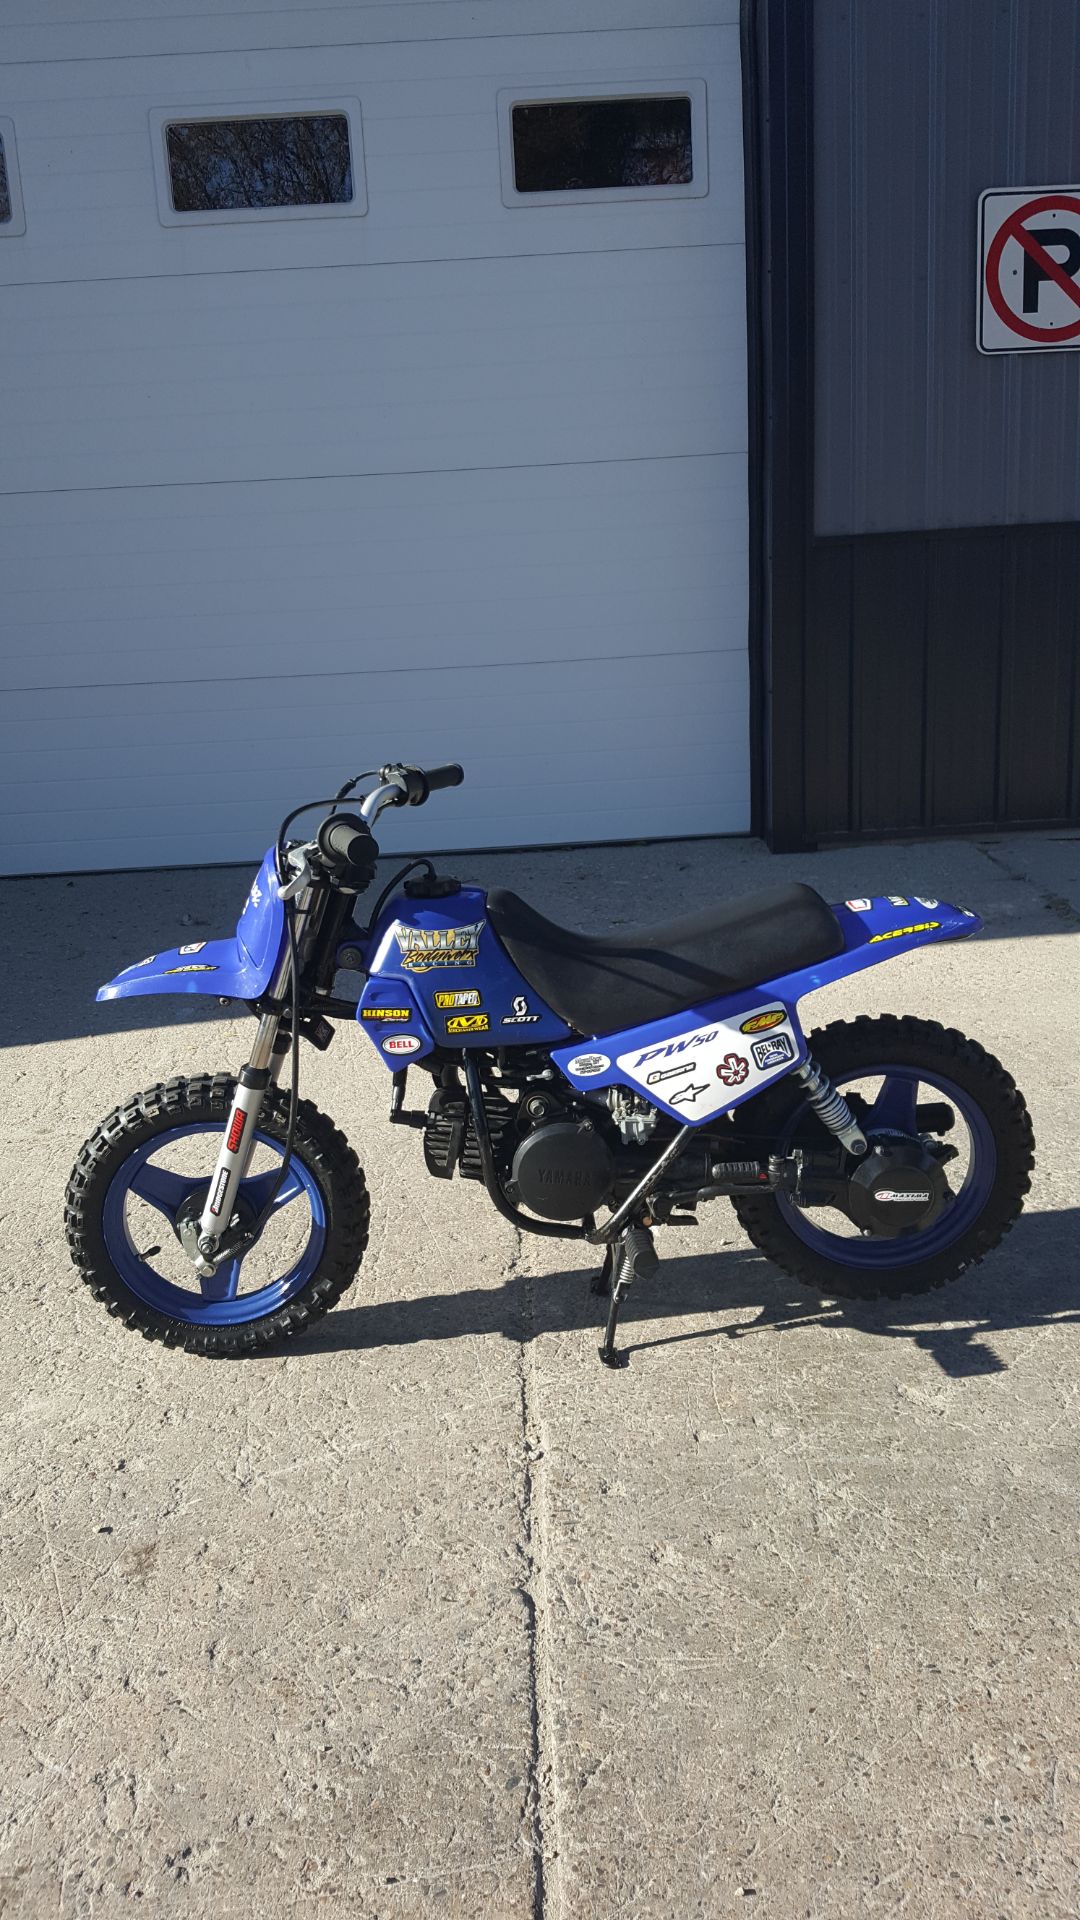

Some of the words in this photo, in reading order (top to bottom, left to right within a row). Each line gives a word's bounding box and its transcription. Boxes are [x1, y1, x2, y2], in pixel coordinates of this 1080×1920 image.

[1022, 228, 1080, 314] P
[395, 920, 486, 952] VALLEY
[408, 960, 473, 968] RACING
[362, 1009, 410, 1018] HINSON
[502, 1015, 539, 1024] SCOTT
[741, 1011, 785, 1032] FMF
[389, 1040, 415, 1049] BELL
[633, 1030, 720, 1069] PW50
[228, 1109, 245, 1153] SHOWA
